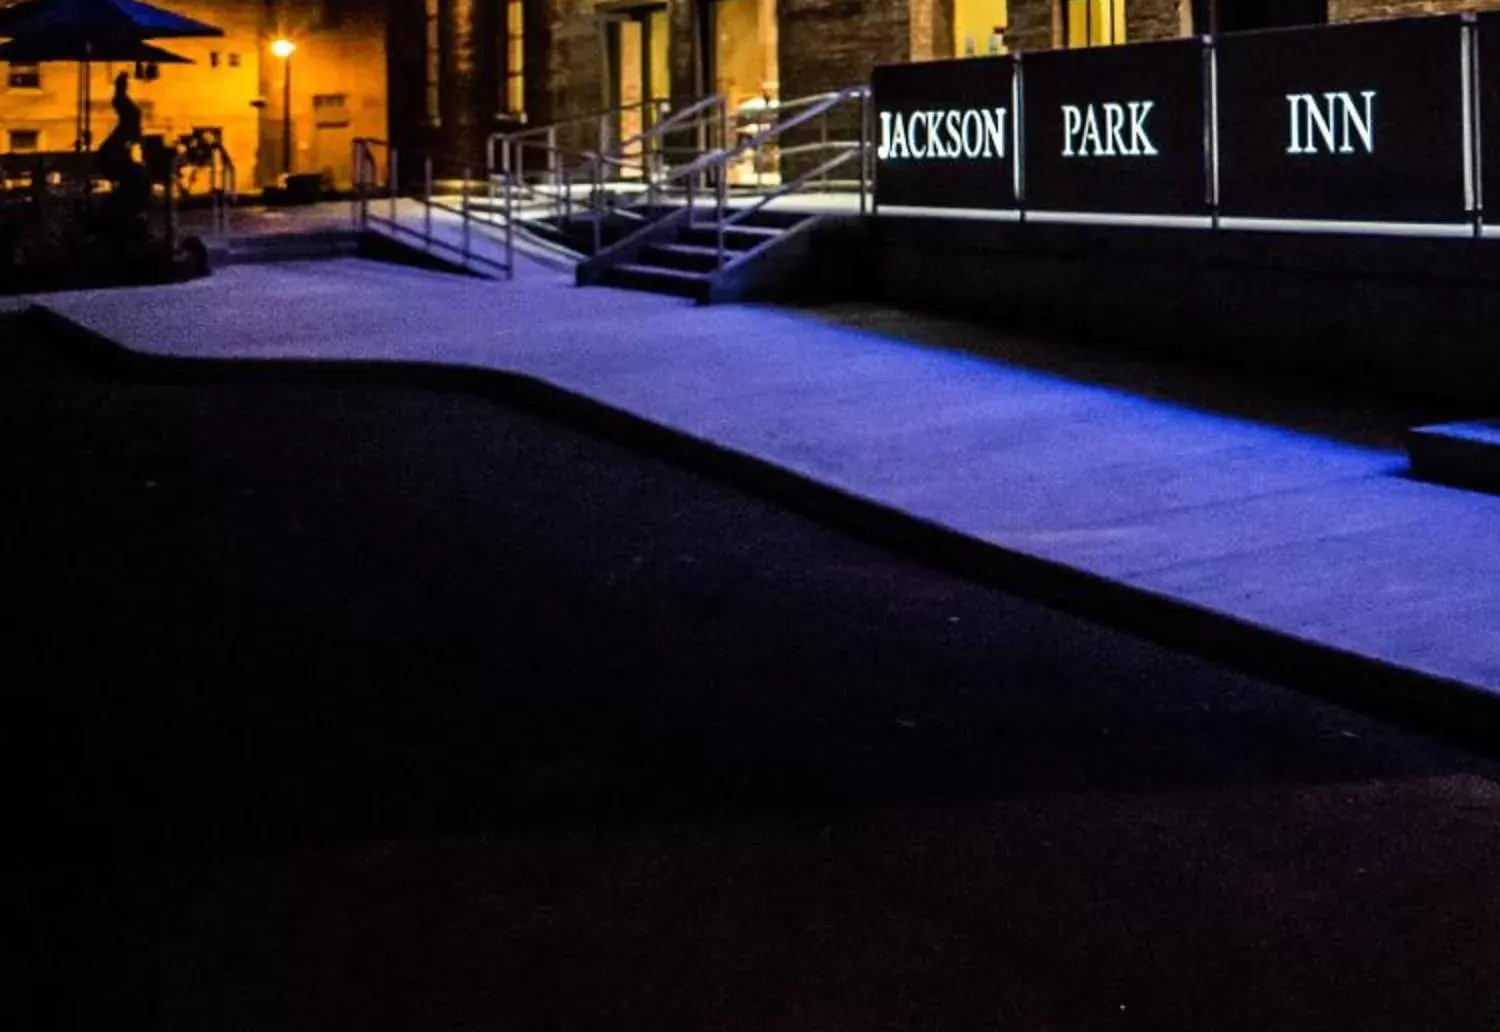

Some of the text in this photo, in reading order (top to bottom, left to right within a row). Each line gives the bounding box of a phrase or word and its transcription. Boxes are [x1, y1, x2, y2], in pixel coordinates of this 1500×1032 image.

[877, 91, 1376, 160] JACKSON PARK INN
